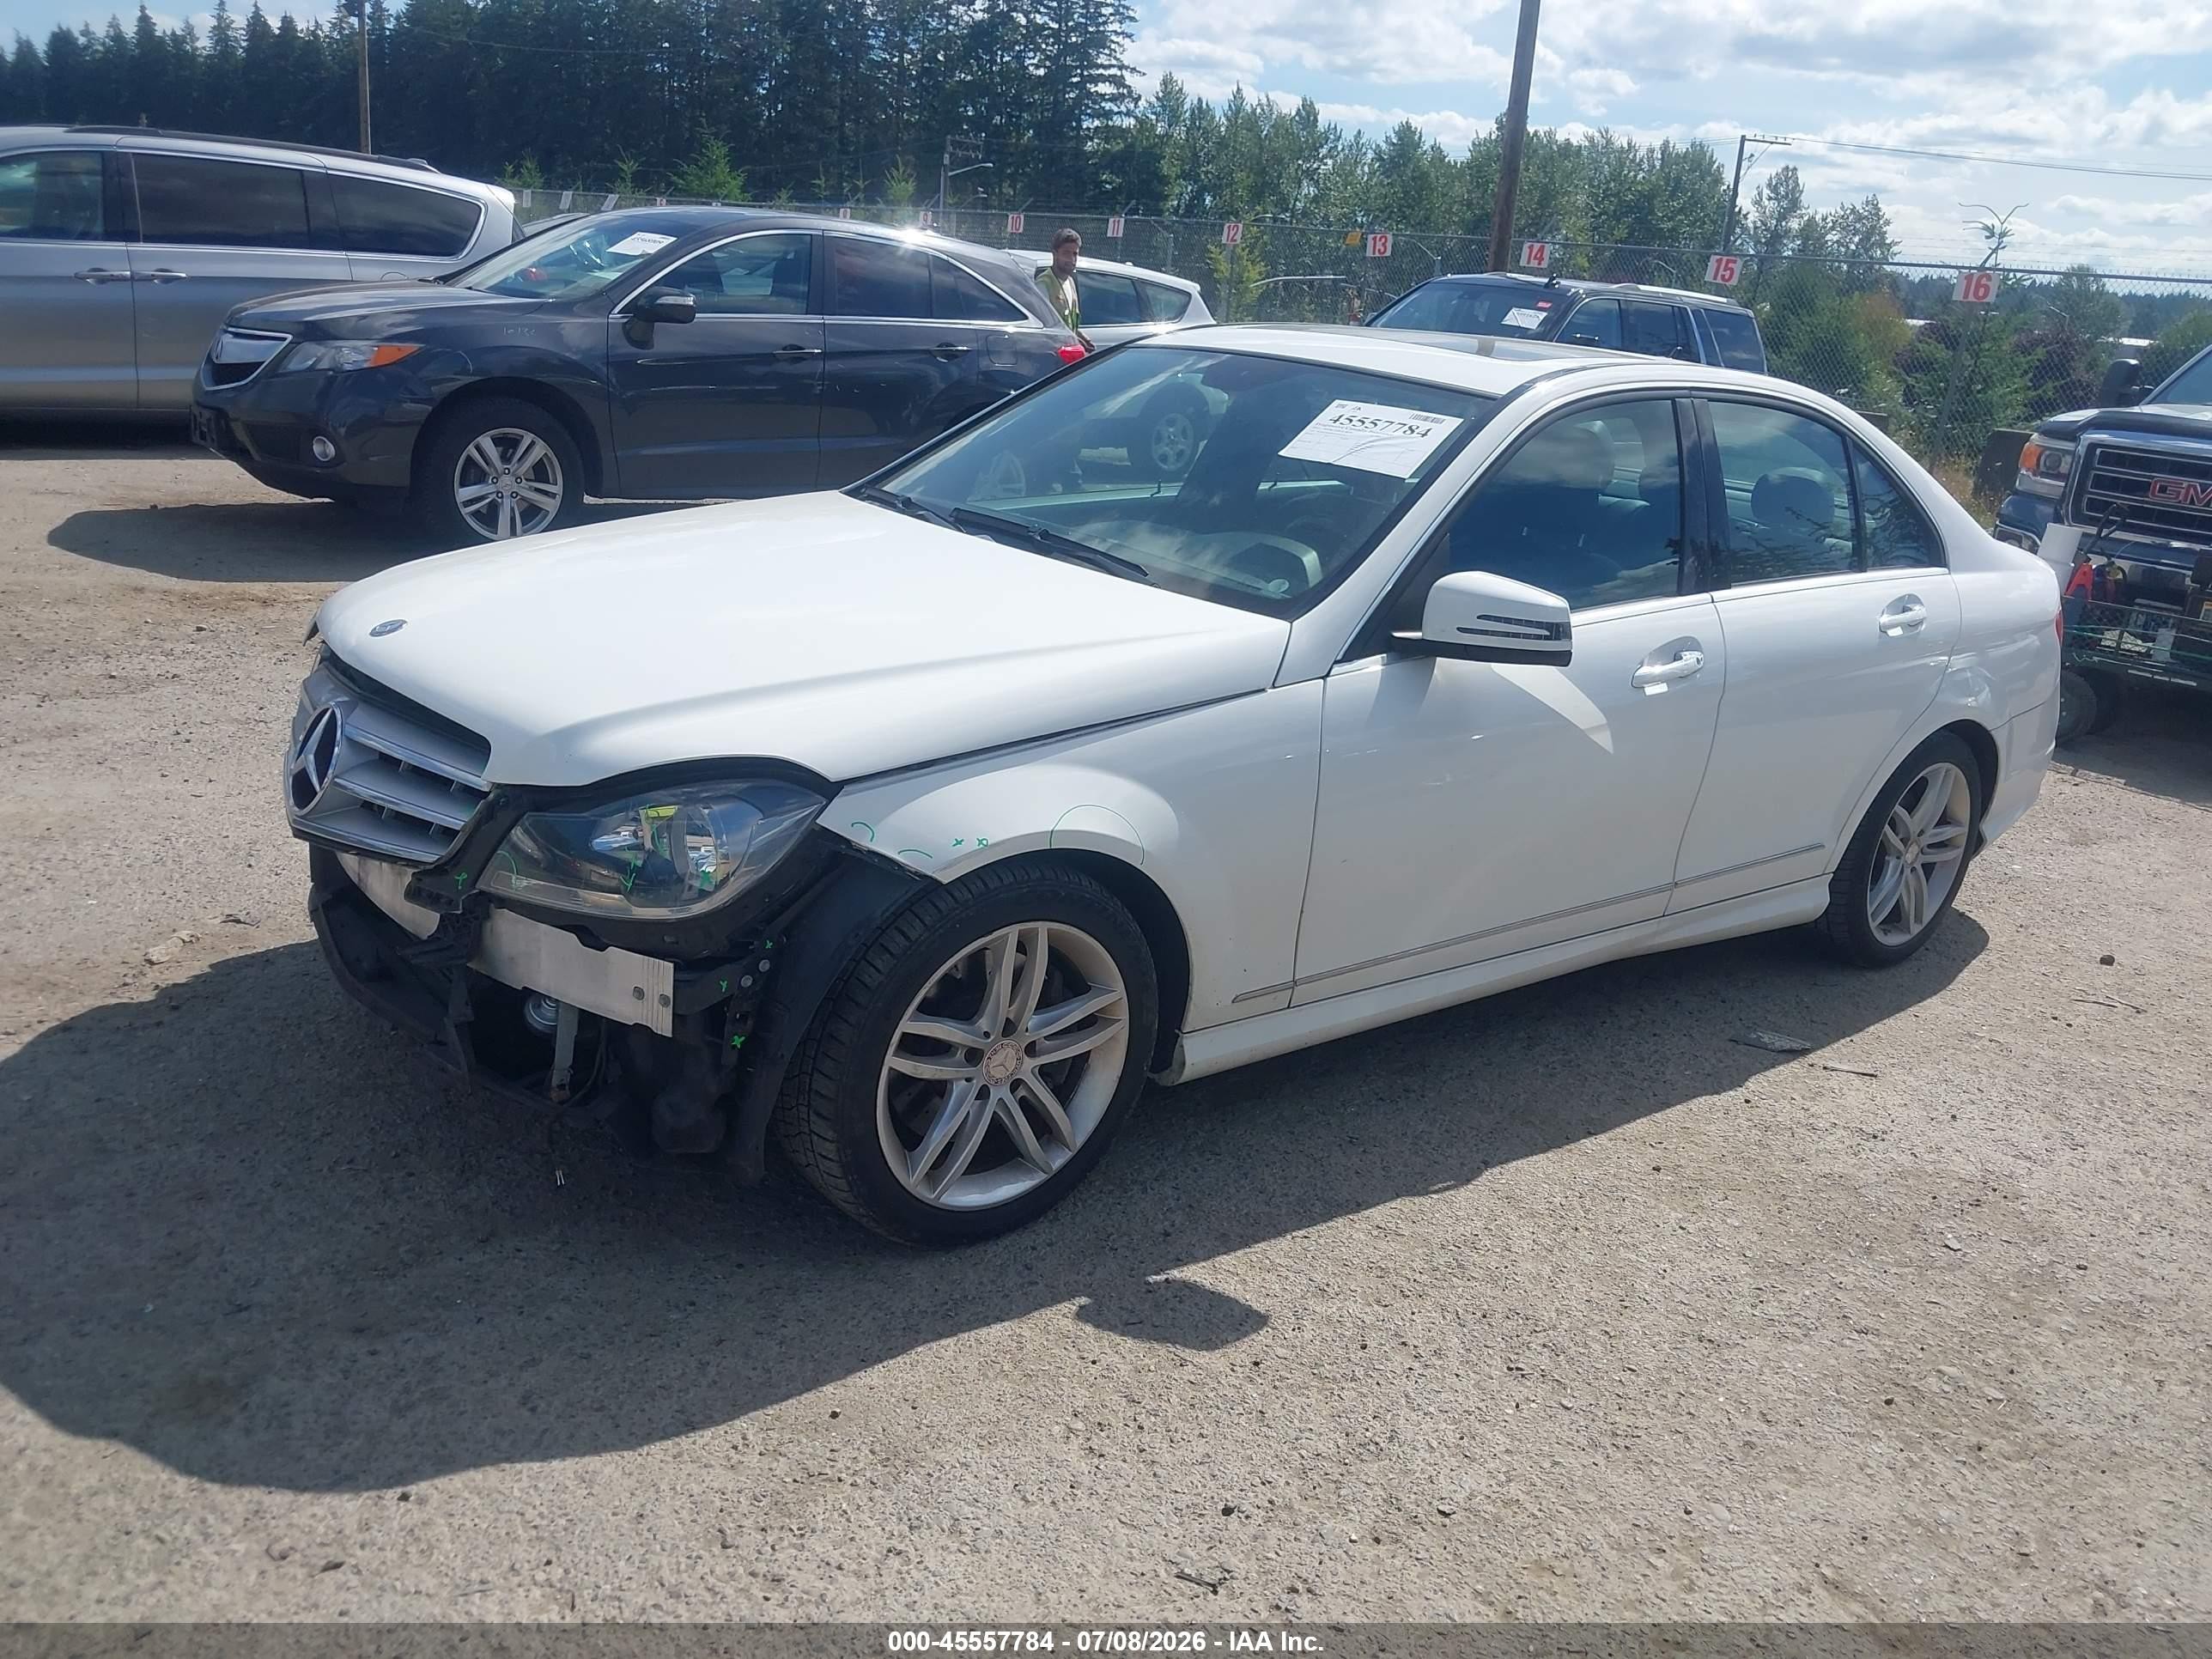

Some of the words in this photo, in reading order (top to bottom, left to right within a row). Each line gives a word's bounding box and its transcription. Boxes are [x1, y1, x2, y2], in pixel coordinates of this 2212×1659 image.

[1011, 216, 1022, 232] 10
[1112, 219, 1121, 236] 11
[1226, 224, 1239, 242] 12
[1372, 235, 1388, 255] 13
[1526, 244, 1546, 266] 14
[1713, 258, 1738, 283] 15
[1962, 273, 1992, 301] 16
[1328, 413, 1433, 439] 45557784
